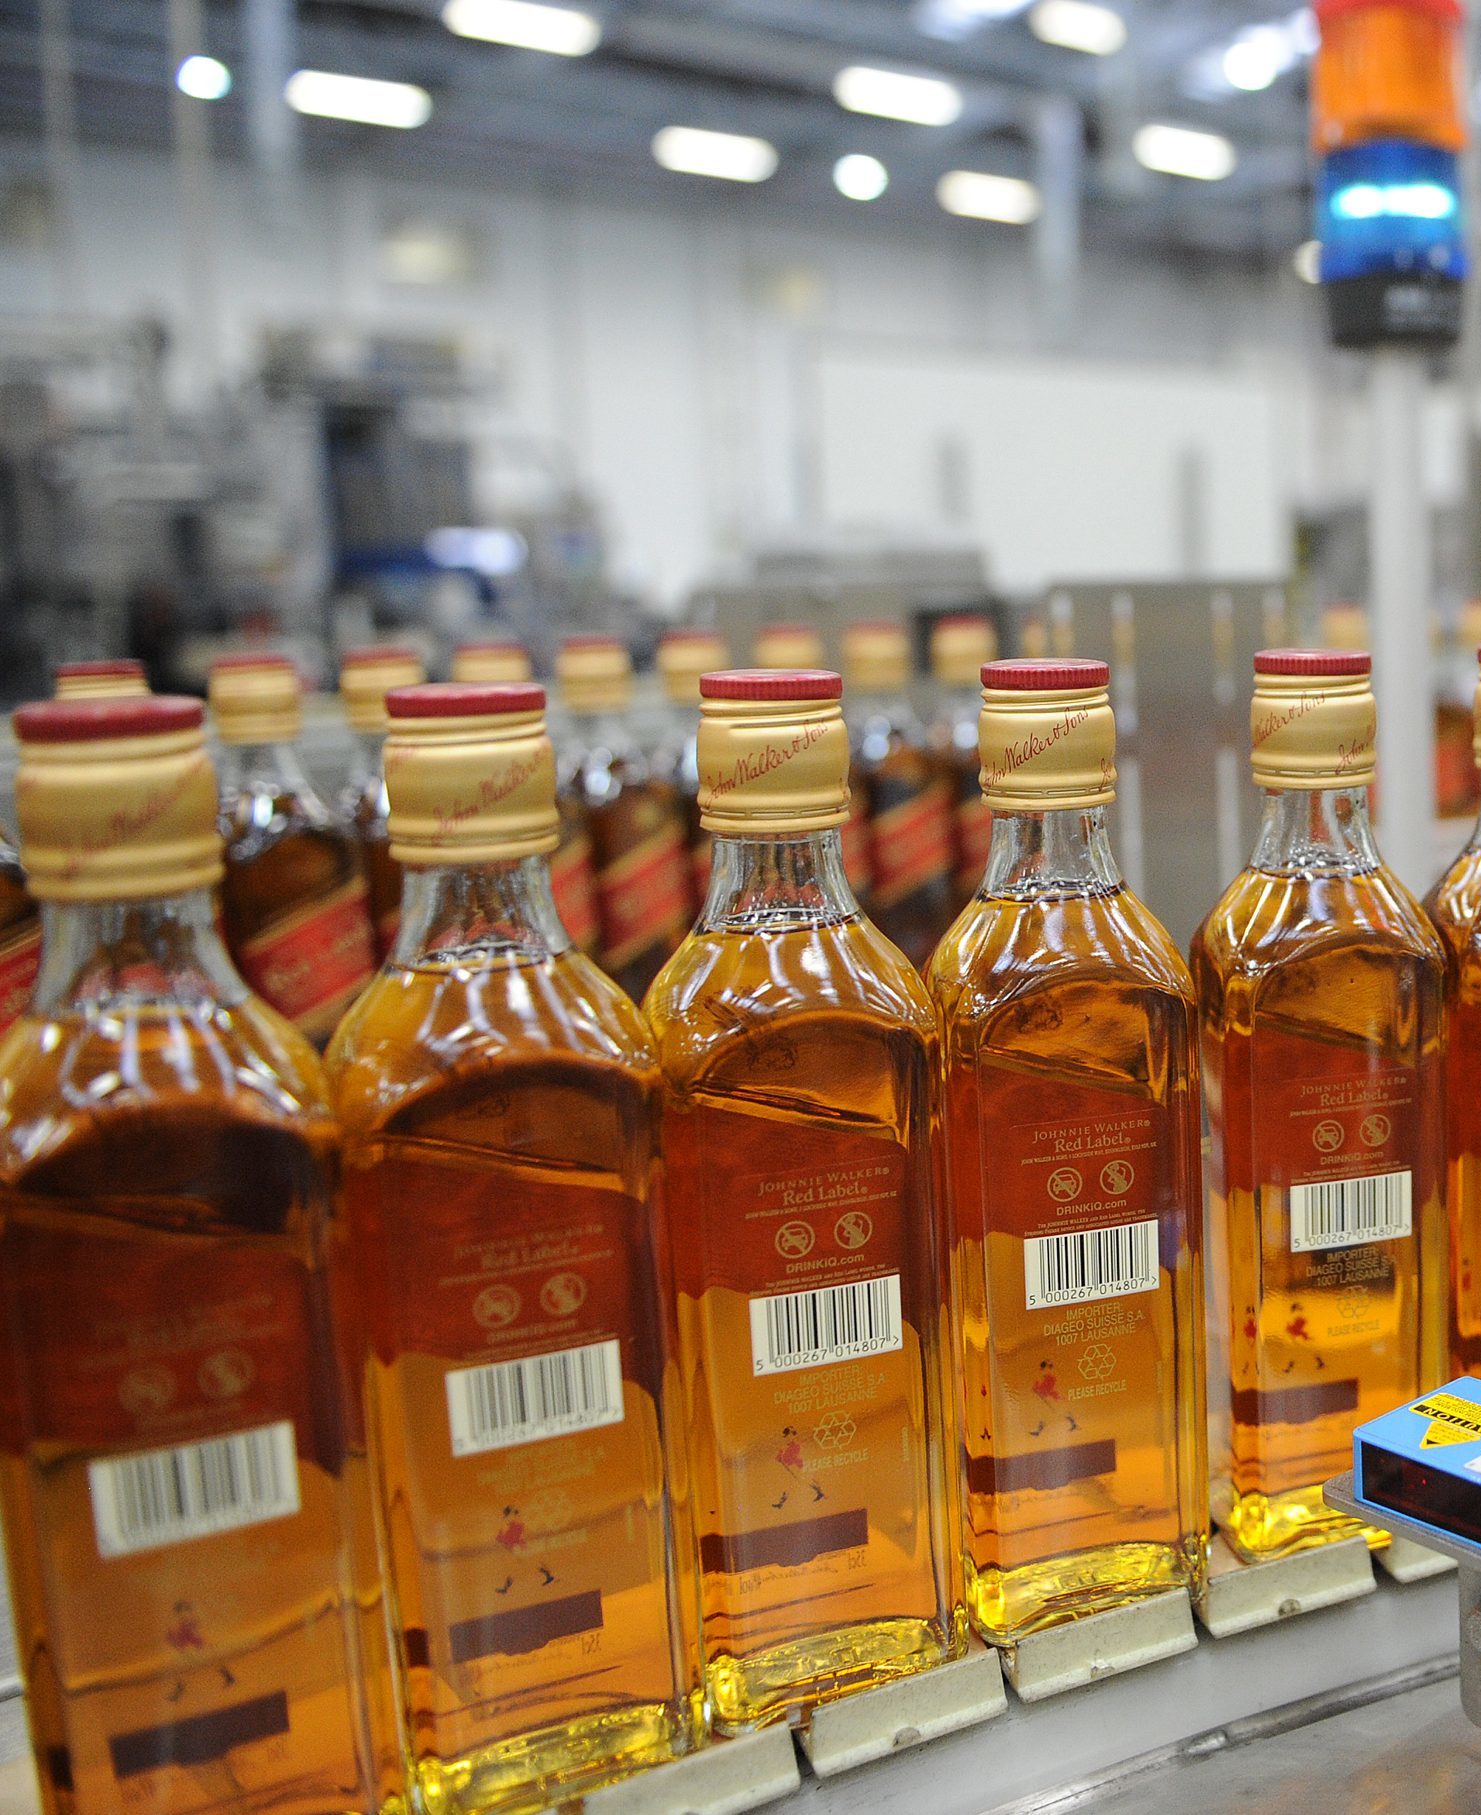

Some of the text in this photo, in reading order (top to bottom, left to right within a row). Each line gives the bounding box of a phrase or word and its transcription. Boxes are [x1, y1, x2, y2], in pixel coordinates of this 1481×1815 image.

[1004, 733, 1053, 773] Walker
[736, 745, 792, 784] Walker
[1033, 1127, 1091, 1144] JOHNNIE
[1055, 1138, 1082, 1153] Red
[758, 1176, 823, 1196] JOHNNIE
[783, 1189, 814, 1206] Red
[1308, 1232, 1352, 1246] 000267
[1358, 1224, 1400, 1240] 014807
[1306, 1263, 1343, 1277] DIAGEO
[1346, 1257, 1380, 1271] SUISSE
[1340, 1266, 1390, 1284] LAUSANNE
[1030, 1278, 1145, 1305] 5 000267 014807
[1044, 1319, 1084, 1336] DIAGEO
[1087, 1312, 1124, 1330] SUISSE
[1055, 1322, 1136, 1346] 1007 LAUSANNE
[756, 1338, 886, 1370] 5 000267 014807
[1068, 1380, 1127, 1400] PLEASE RECYCLE
[788, 1401, 812, 1415] 1007
